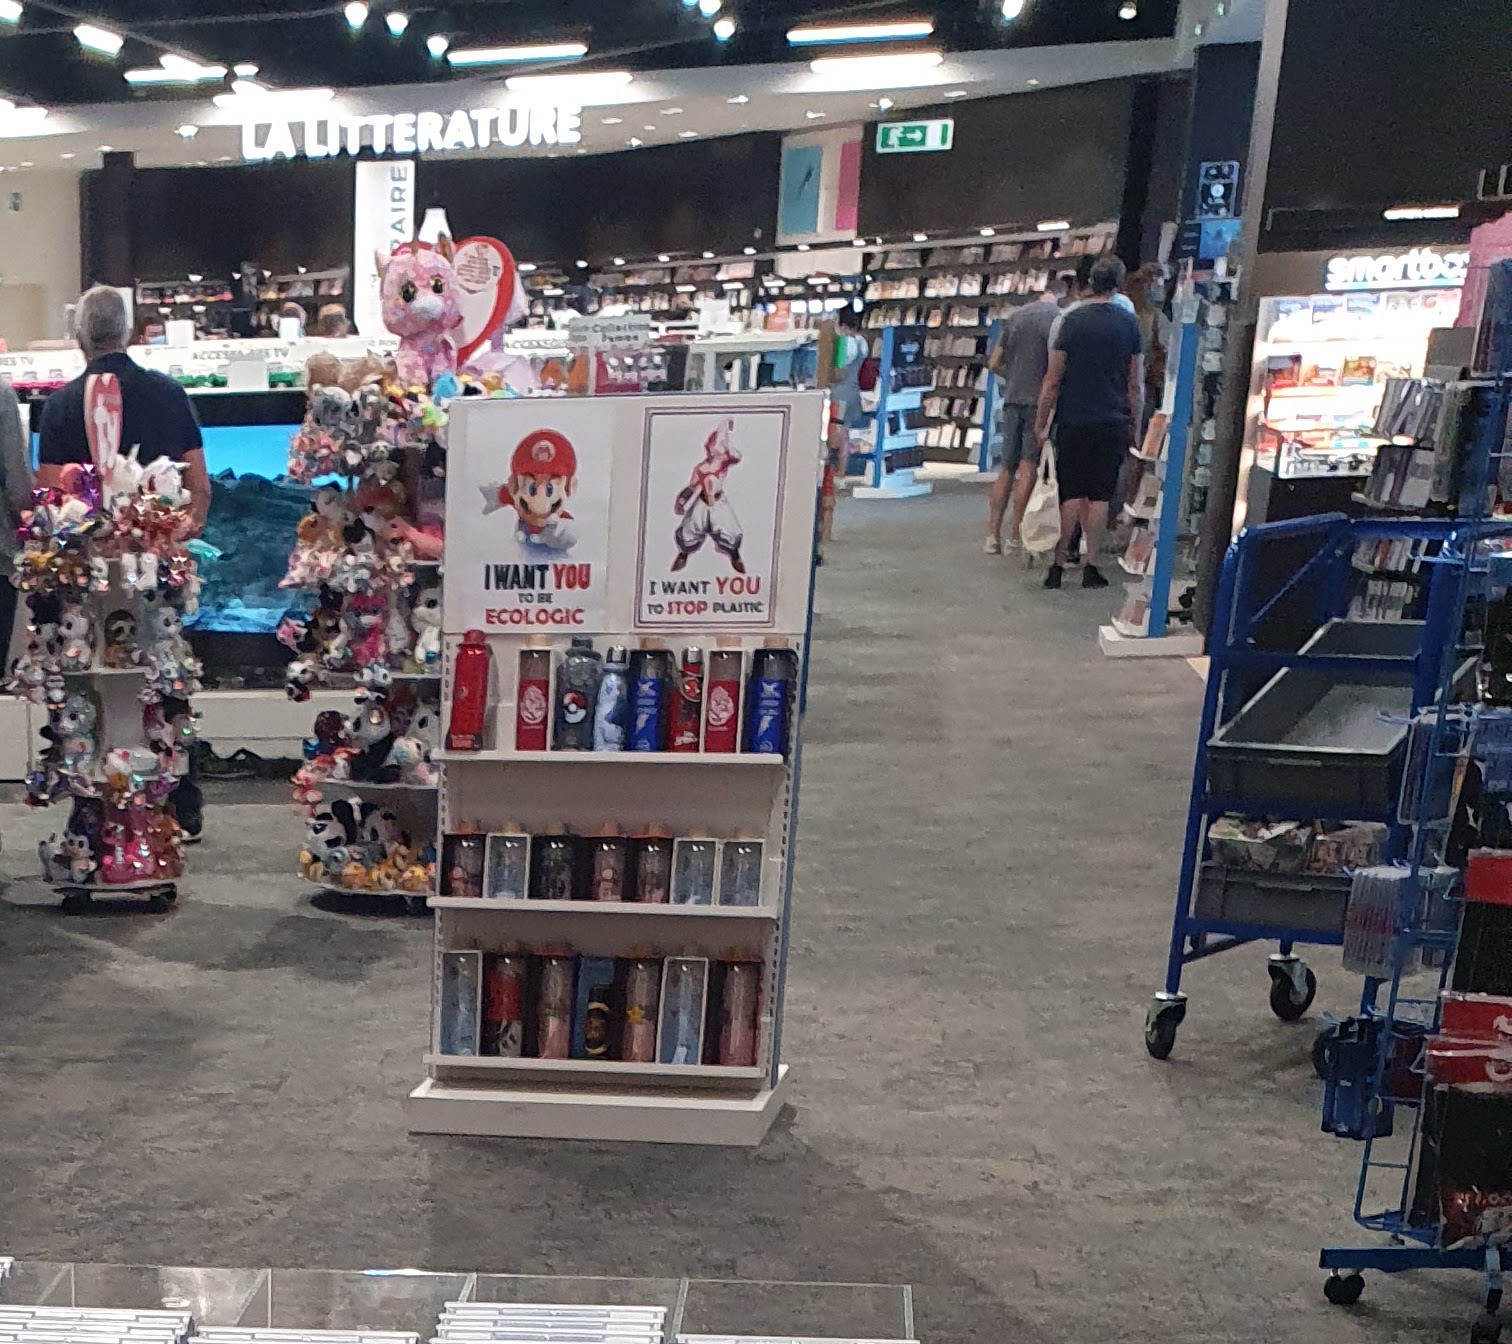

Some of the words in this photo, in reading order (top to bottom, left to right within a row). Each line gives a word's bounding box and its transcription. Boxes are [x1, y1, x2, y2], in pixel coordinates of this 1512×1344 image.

[242, 119, 295, 160] LA
[304, 105, 582, 158] LITTERATURE
[492, 564, 550, 591] WANT
[552, 562, 591, 590] YOU
[661, 580, 711, 596] WANT
[714, 576, 762, 597] YOU
[518, 593, 532, 604] TO
[666, 600, 708, 616] STOP
[712, 601, 764, 615] PLASTIC
[485, 608, 585, 626] ECOLOGIC
